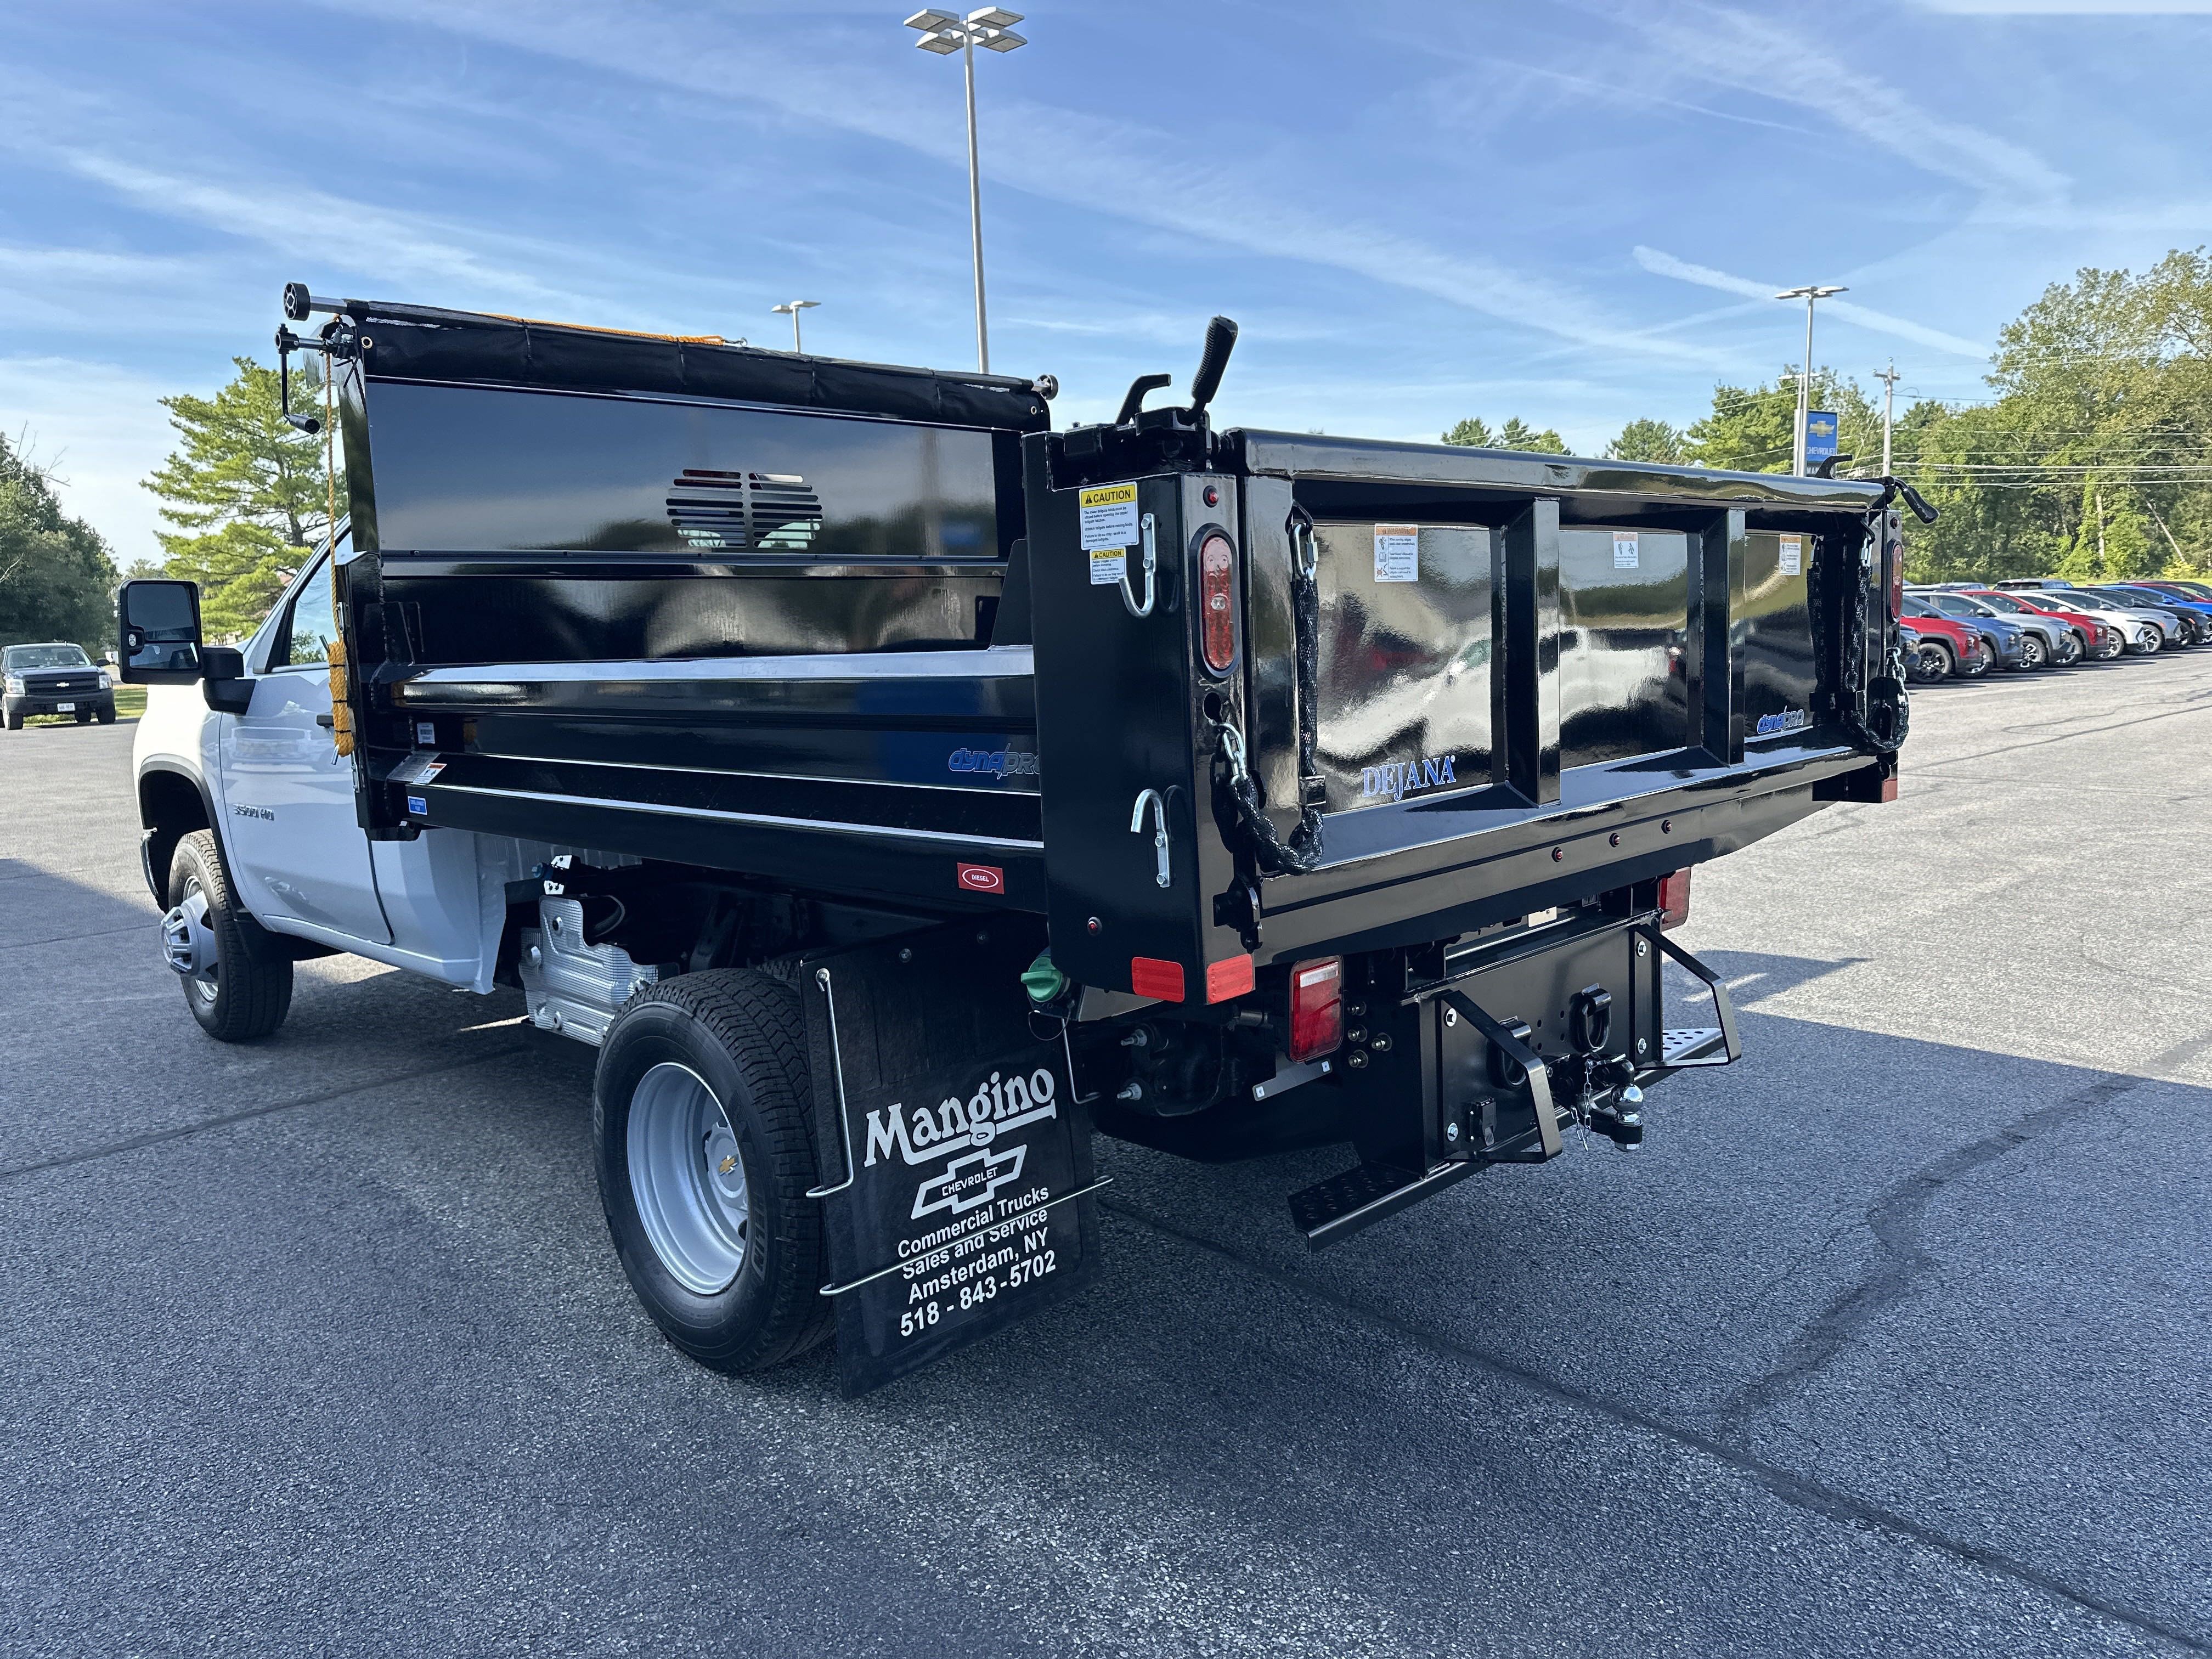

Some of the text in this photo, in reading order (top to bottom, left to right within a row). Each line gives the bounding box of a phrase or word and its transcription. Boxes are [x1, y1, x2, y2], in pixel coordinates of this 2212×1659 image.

[1807, 447, 1836, 455] CHEVROLET
[1093, 489, 1131, 503] CAUTION
[971, 874, 990, 882] DIESEL
[864, 1068, 1056, 1167] Mangino
[942, 1167, 998, 1197] CHEVROLET
[898, 1187, 1049, 1258] Commercial Trucks
[902, 1209, 1048, 1279] Sales and Service
[909, 1227, 1048, 1305] Amsterdam, NY
